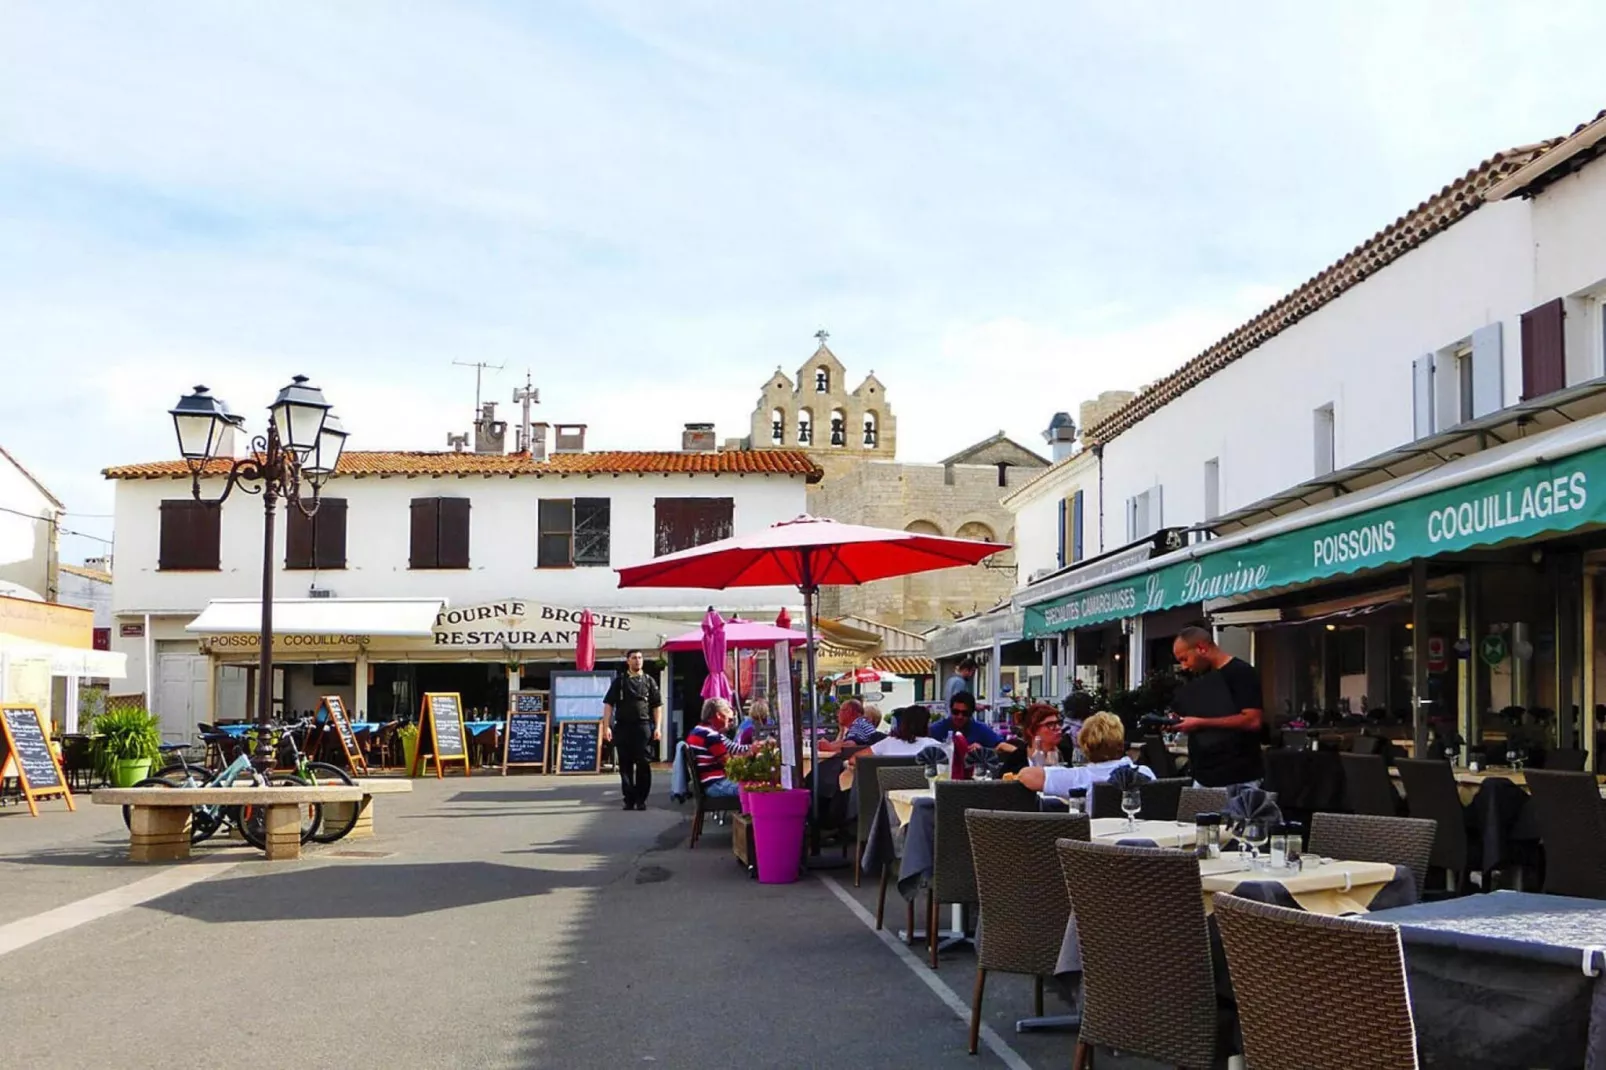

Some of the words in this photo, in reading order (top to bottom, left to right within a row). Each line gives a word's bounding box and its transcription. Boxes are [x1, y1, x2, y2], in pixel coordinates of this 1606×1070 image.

[1314, 520, 1396, 567] POISSONS
[1427, 471, 1587, 543] COQUILLAGES
[1144, 572, 1165, 610] La
[436, 602, 525, 626] TOURNE
[541, 606, 631, 631] BROCHE
[210, 635, 274, 646] POISSO
[283, 634, 371, 645] COQUILLAGES
